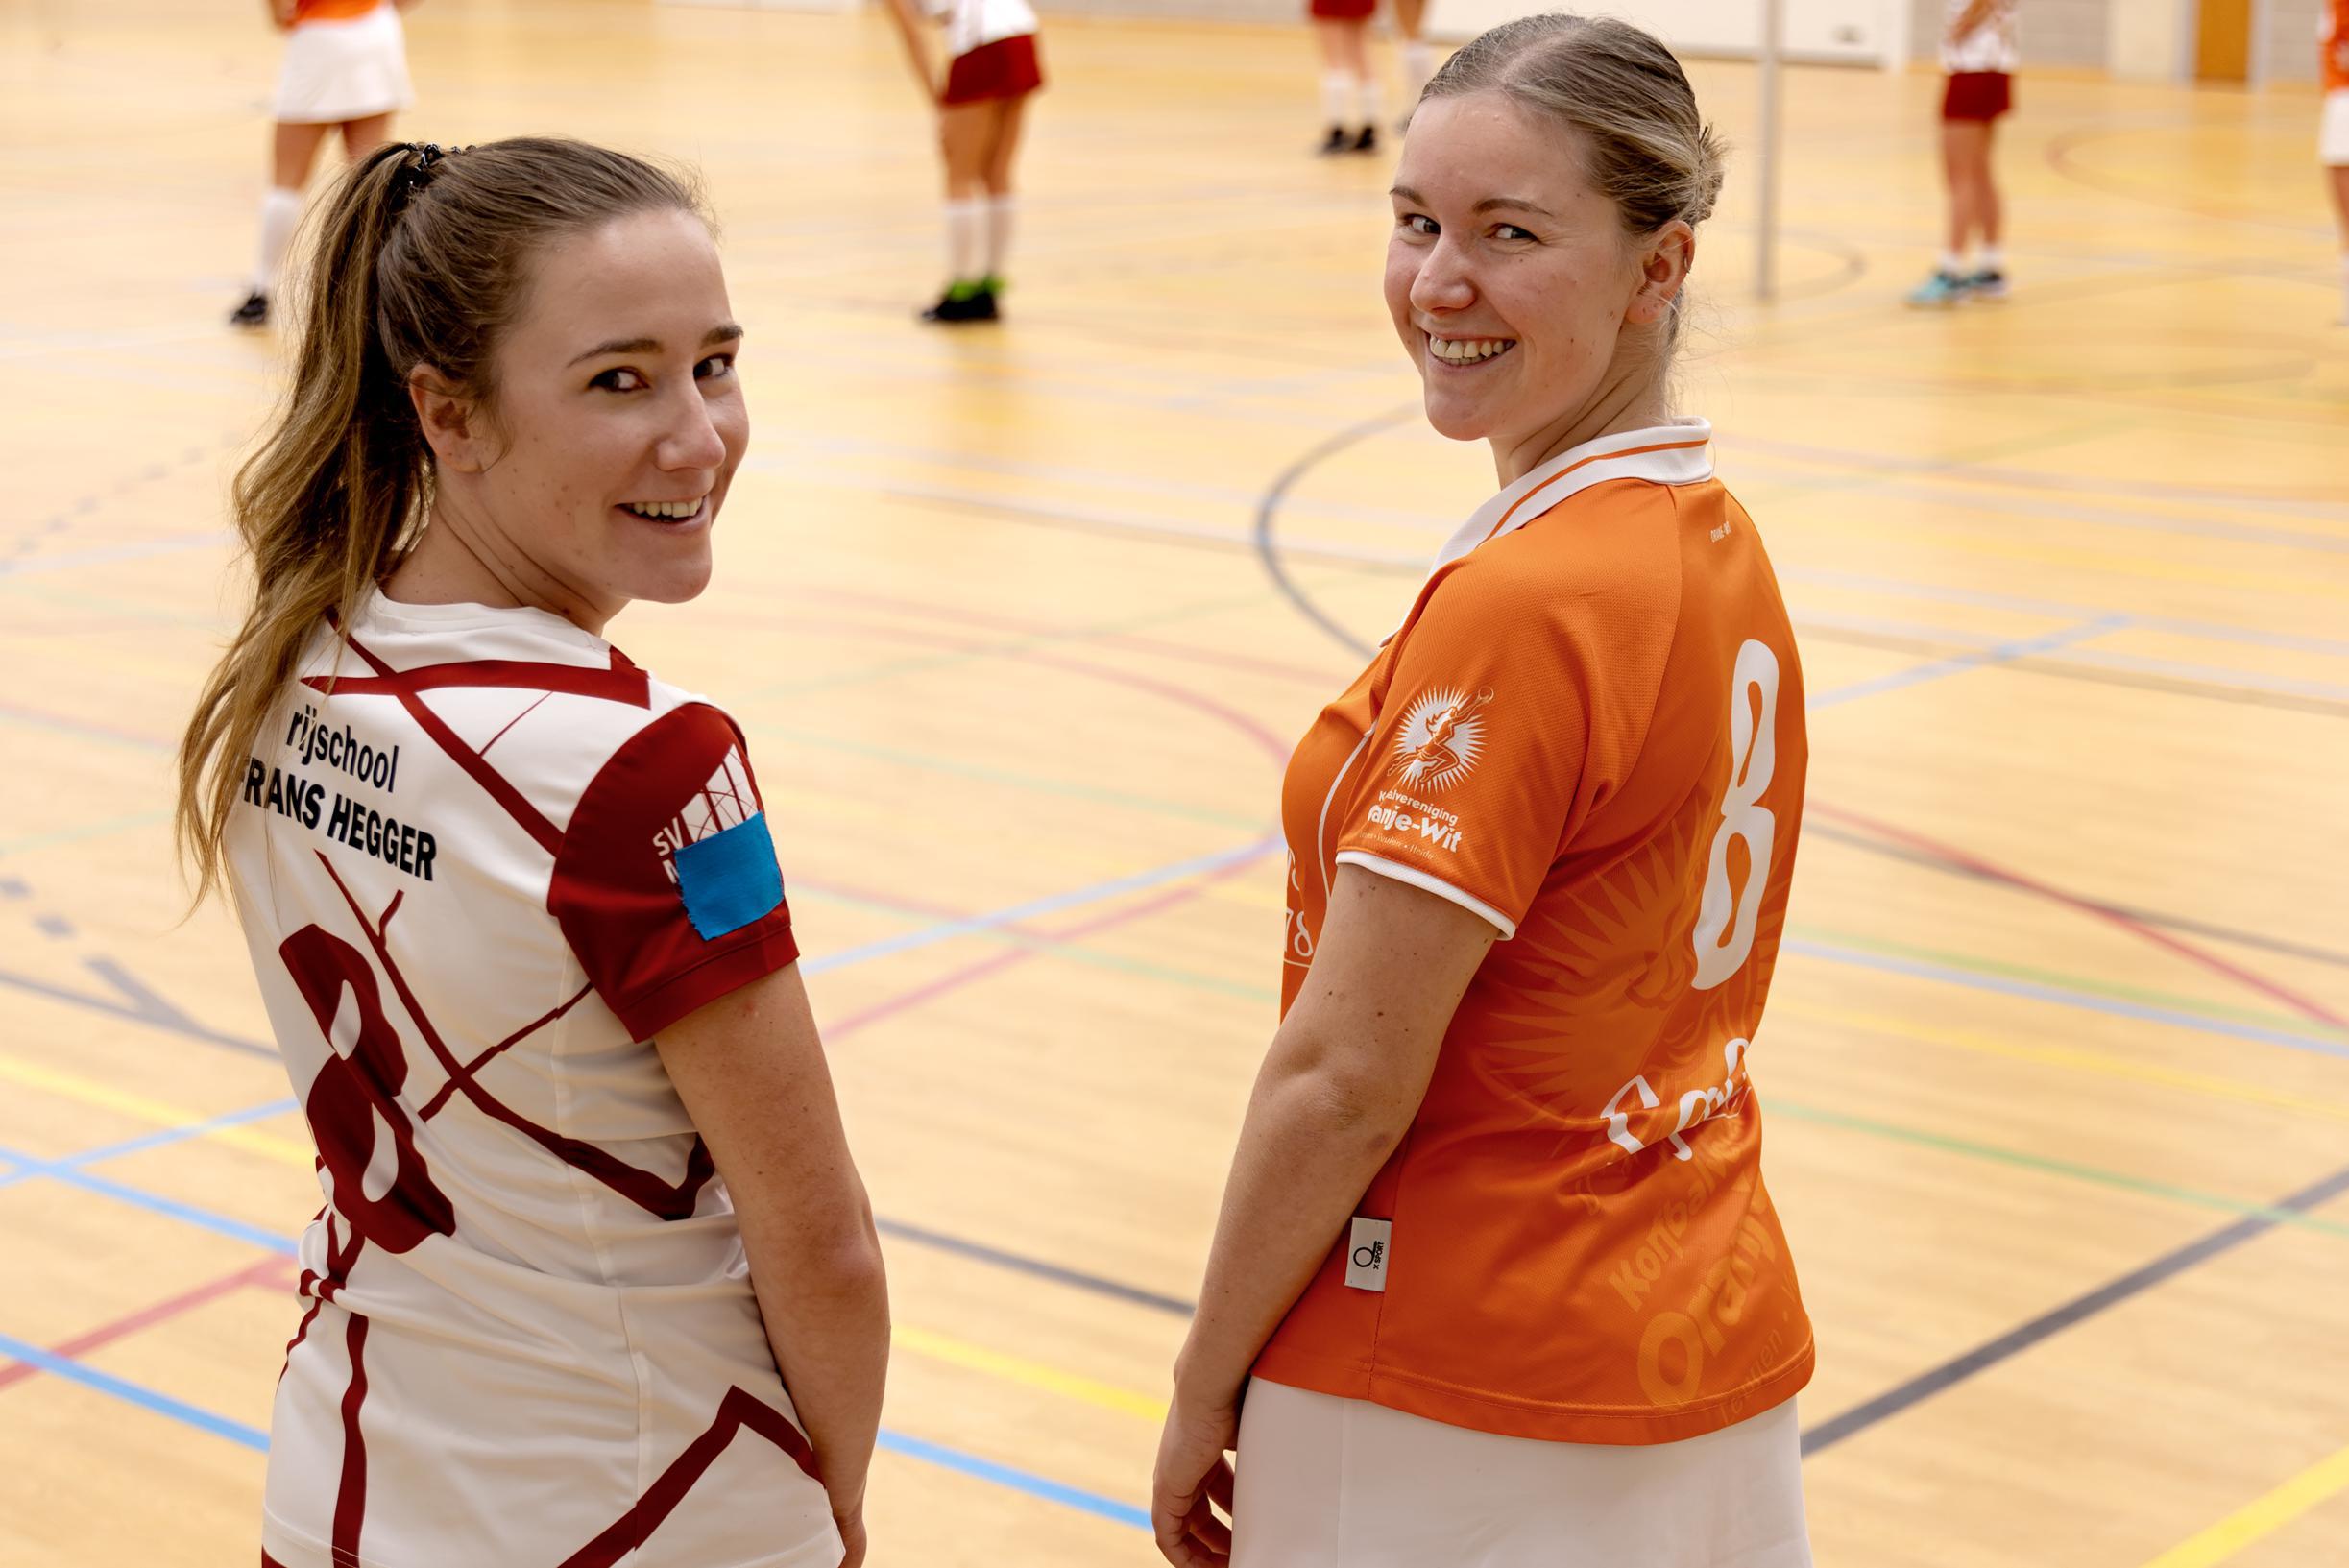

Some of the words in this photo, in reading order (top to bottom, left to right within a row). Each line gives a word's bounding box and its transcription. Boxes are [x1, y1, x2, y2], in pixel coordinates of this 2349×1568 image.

[285, 704, 400, 793] rijschool
[241, 756, 326, 831] RANS
[327, 792, 437, 882] HEGGER
[652, 816, 683, 856] SV
[1368, 804, 1463, 853] anje-Wit
[1691, 639, 1779, 990] 8
[278, 923, 457, 1254] 8
